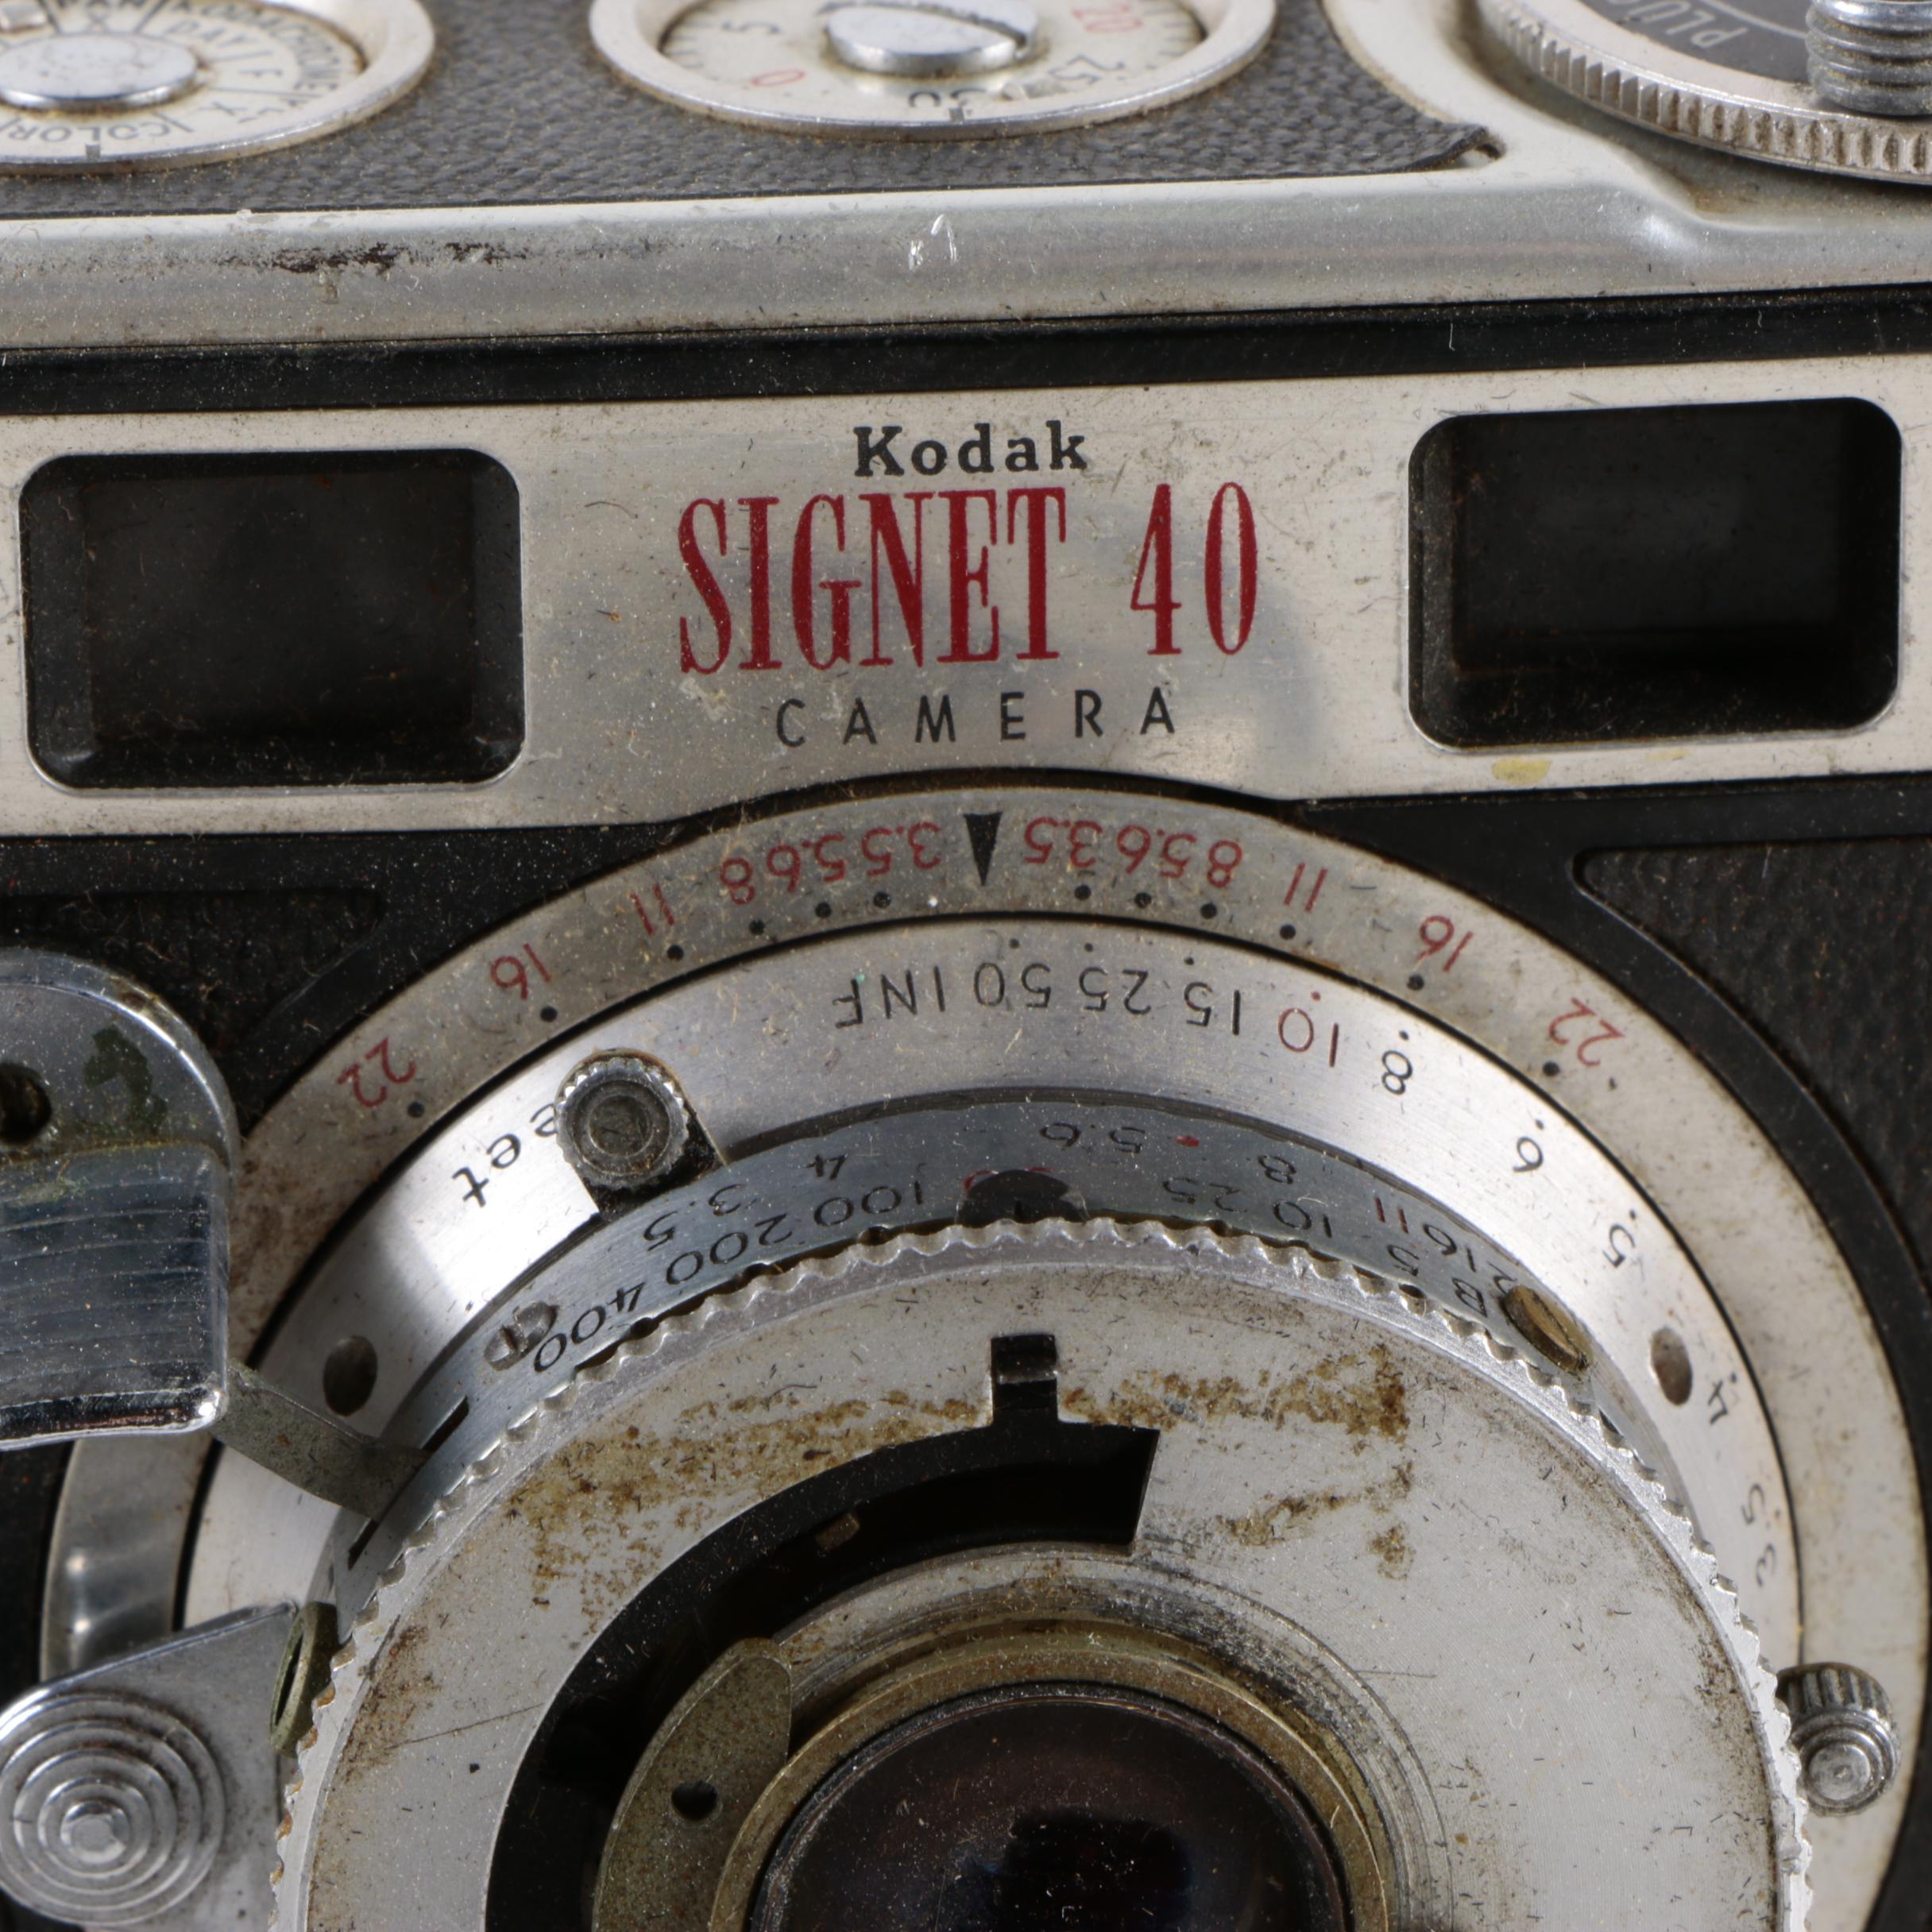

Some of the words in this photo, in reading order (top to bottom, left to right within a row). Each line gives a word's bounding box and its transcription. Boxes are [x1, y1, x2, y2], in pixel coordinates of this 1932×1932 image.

[1048, 53, 1126, 85] 25
[1606, 0, 1748, 48] PLU
[751, 69, 806, 87] 0
[8, 122, 171, 142] COLOR
[853, 420, 1087, 477] Kodak
[677, 486, 1066, 674] SIGNET
[1129, 481, 1258, 655] 40
[775, 686, 1175, 747] CAMERA
[337, 1037, 416, 1107] 22
[490, 943, 552, 1000] 16
[631, 883, 675, 935] 11
[719, 858, 755, 905] 8
[766, 833, 847, 892] 5.6
[861, 821, 941, 876] 3.5
[1024, 817, 1103, 868] 3.5
[1116, 826, 1196, 879] 5.6
[1207, 840, 1242, 888] 8
[1283, 863, 1327, 912] 11
[1417, 915, 1473, 972] 16
[1548, 997, 1625, 1067] 22
[452, 1103, 557, 1208] eet
[643, 1184, 747, 1252] 3.5
[806, 1154, 847, 1180] 4
[1040, 1122, 1146, 1153] 5.6
[1258, 1154, 1296, 1184] 8
[1421, 1223, 1477, 1273] 16
[832, 966, 946, 1029] INF
[973, 962, 1052, 1009] 50
[1078, 967, 1152, 1015] 25
[1184, 981, 1241, 1035] 15
[1277, 1007, 1339, 1068] 10
[1381, 1050, 1413, 1095] 8
[1513, 1137, 1544, 1173] 6
[1603, 1223, 1636, 1268] 5
[1708, 1381, 1729, 1424] 4
[533, 1281, 646, 1373] 400
[666, 1212, 793, 1285] 200
[813, 1180, 923, 1227] 100
[1162, 1176, 1247, 1213] 25
[1273, 1198, 1331, 1238] 10
[1387, 1244, 1420, 1277] 5
[1450, 1277, 1488, 1318] B
